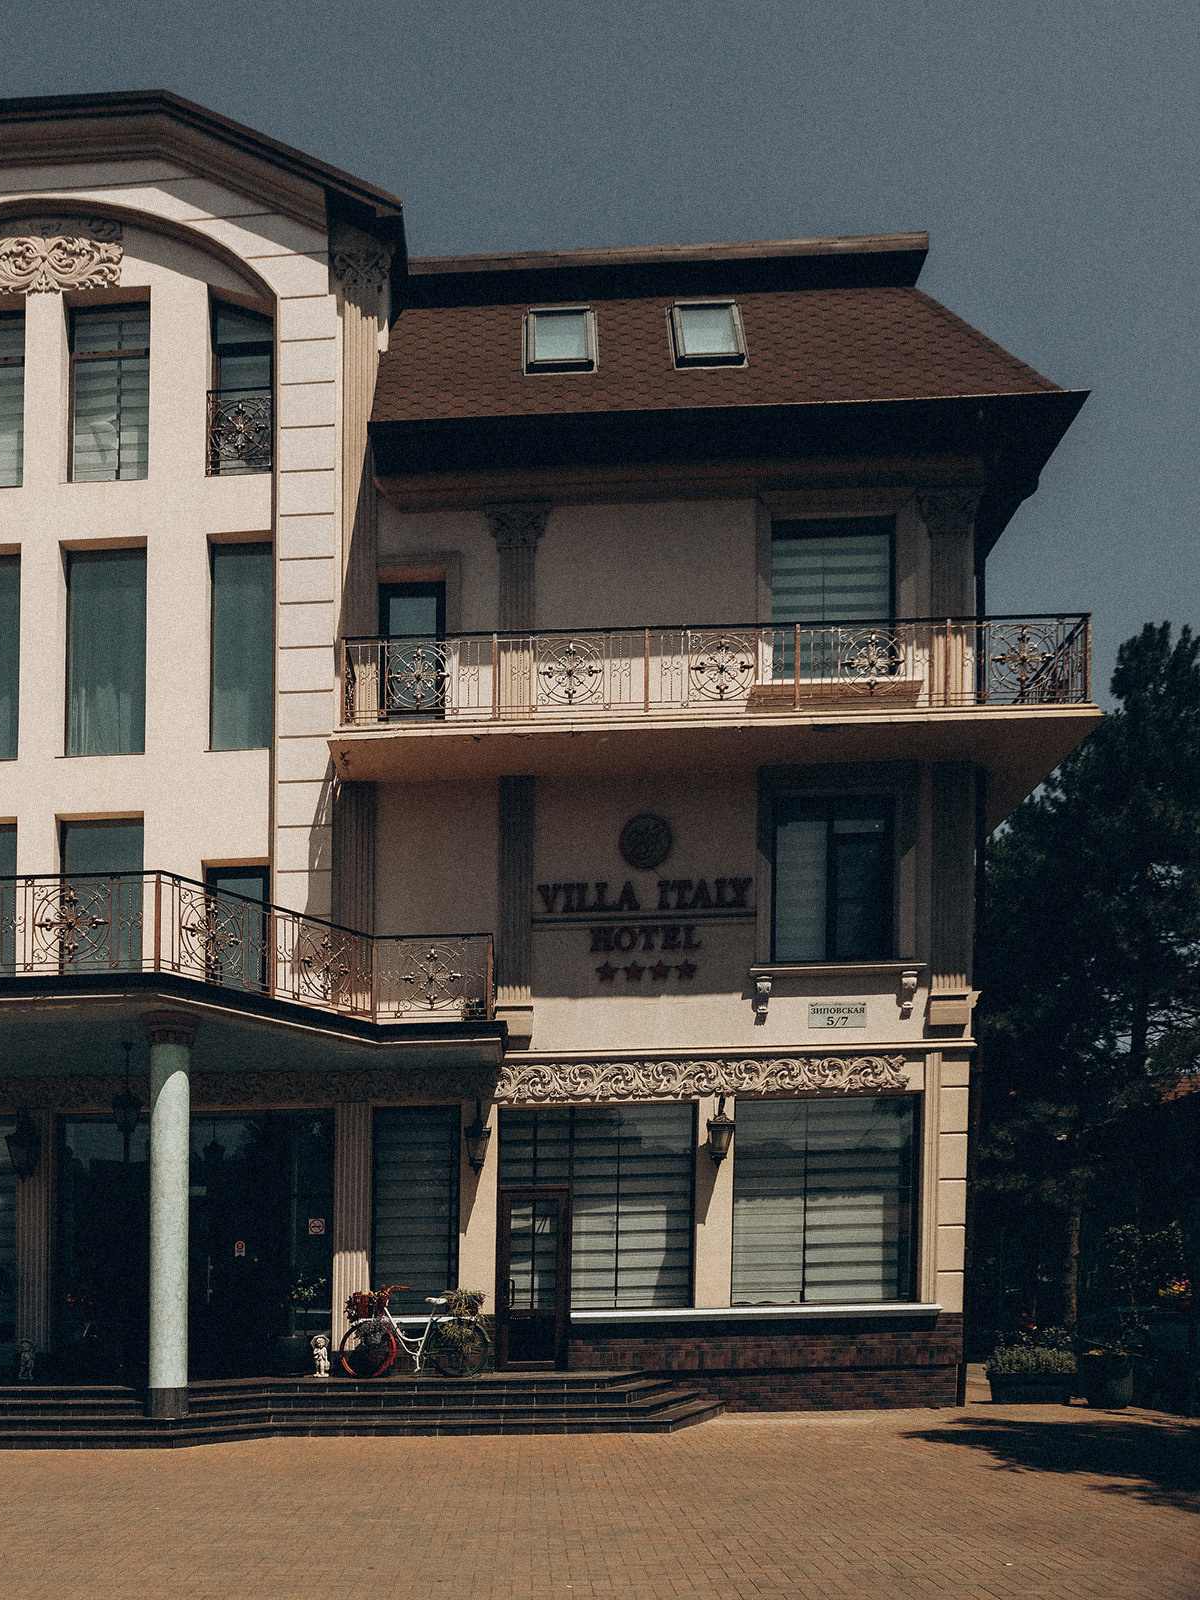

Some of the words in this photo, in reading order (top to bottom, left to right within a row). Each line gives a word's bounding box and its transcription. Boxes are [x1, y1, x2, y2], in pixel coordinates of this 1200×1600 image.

[537, 880, 641, 914] VILLA
[657, 877, 753, 911] ITALY
[589, 924, 702, 952] HOTEL
[810, 1007, 865, 1015] ЗИПОВСКАЯ
[826, 1016, 849, 1027] 5/7
